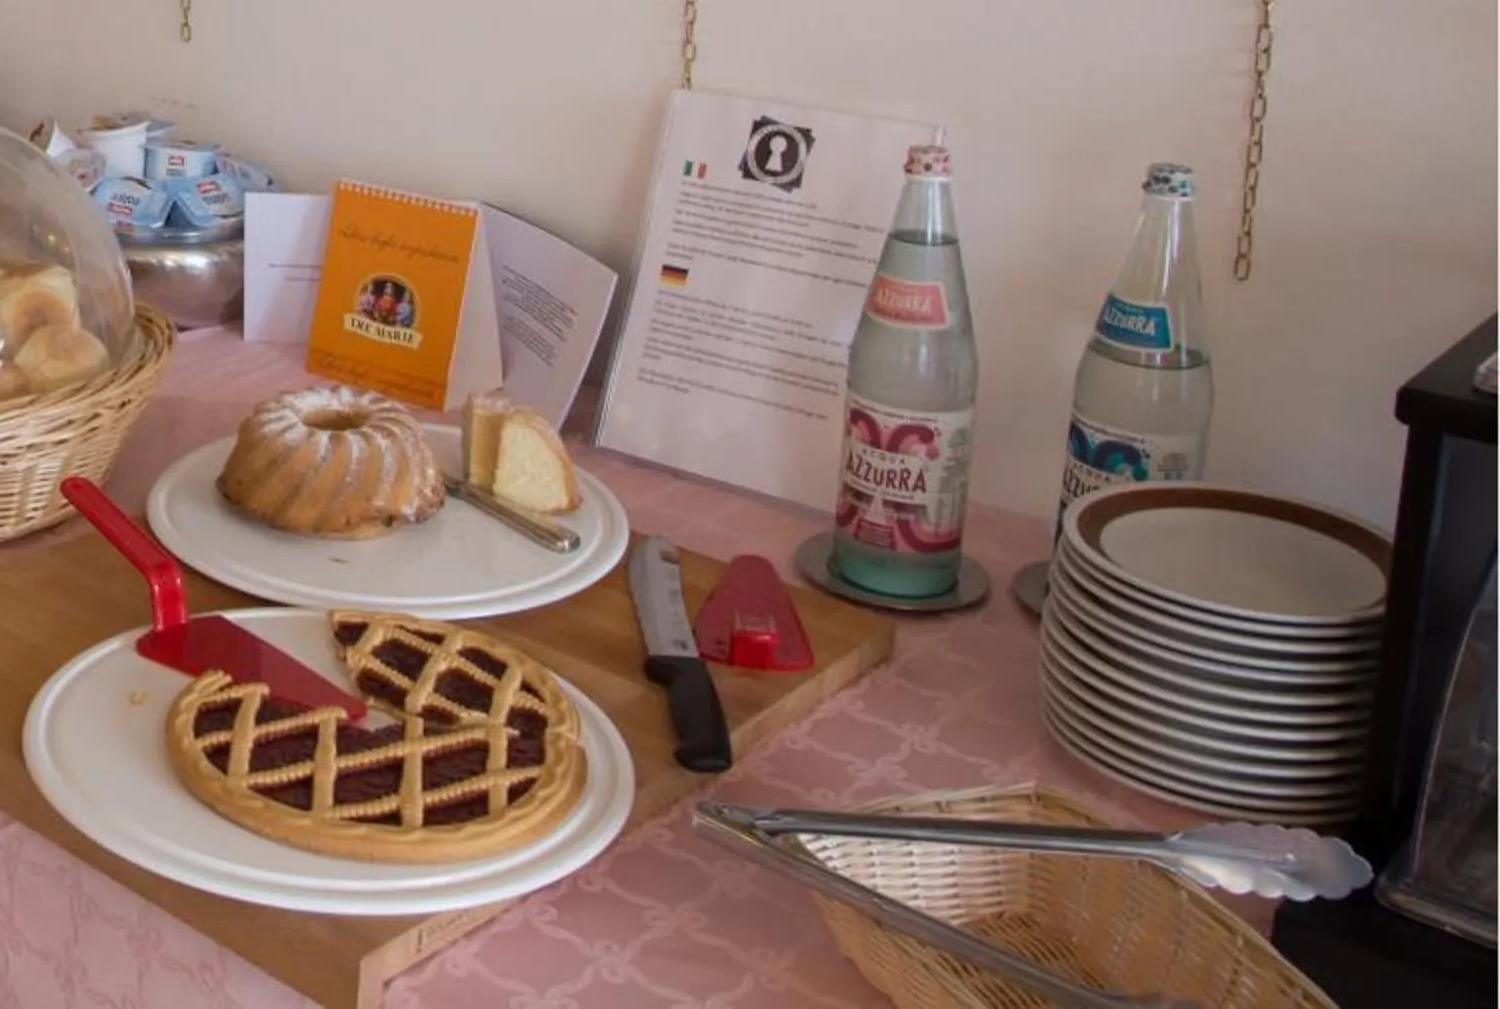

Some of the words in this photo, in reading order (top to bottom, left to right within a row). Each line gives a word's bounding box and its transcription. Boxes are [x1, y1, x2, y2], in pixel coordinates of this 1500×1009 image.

[1103, 304, 1156, 336] AZZURRA
[862, 448, 906, 466] ACQUA
[846, 451, 927, 494] AZZURRA
[1063, 469, 1103, 498] AZZU
